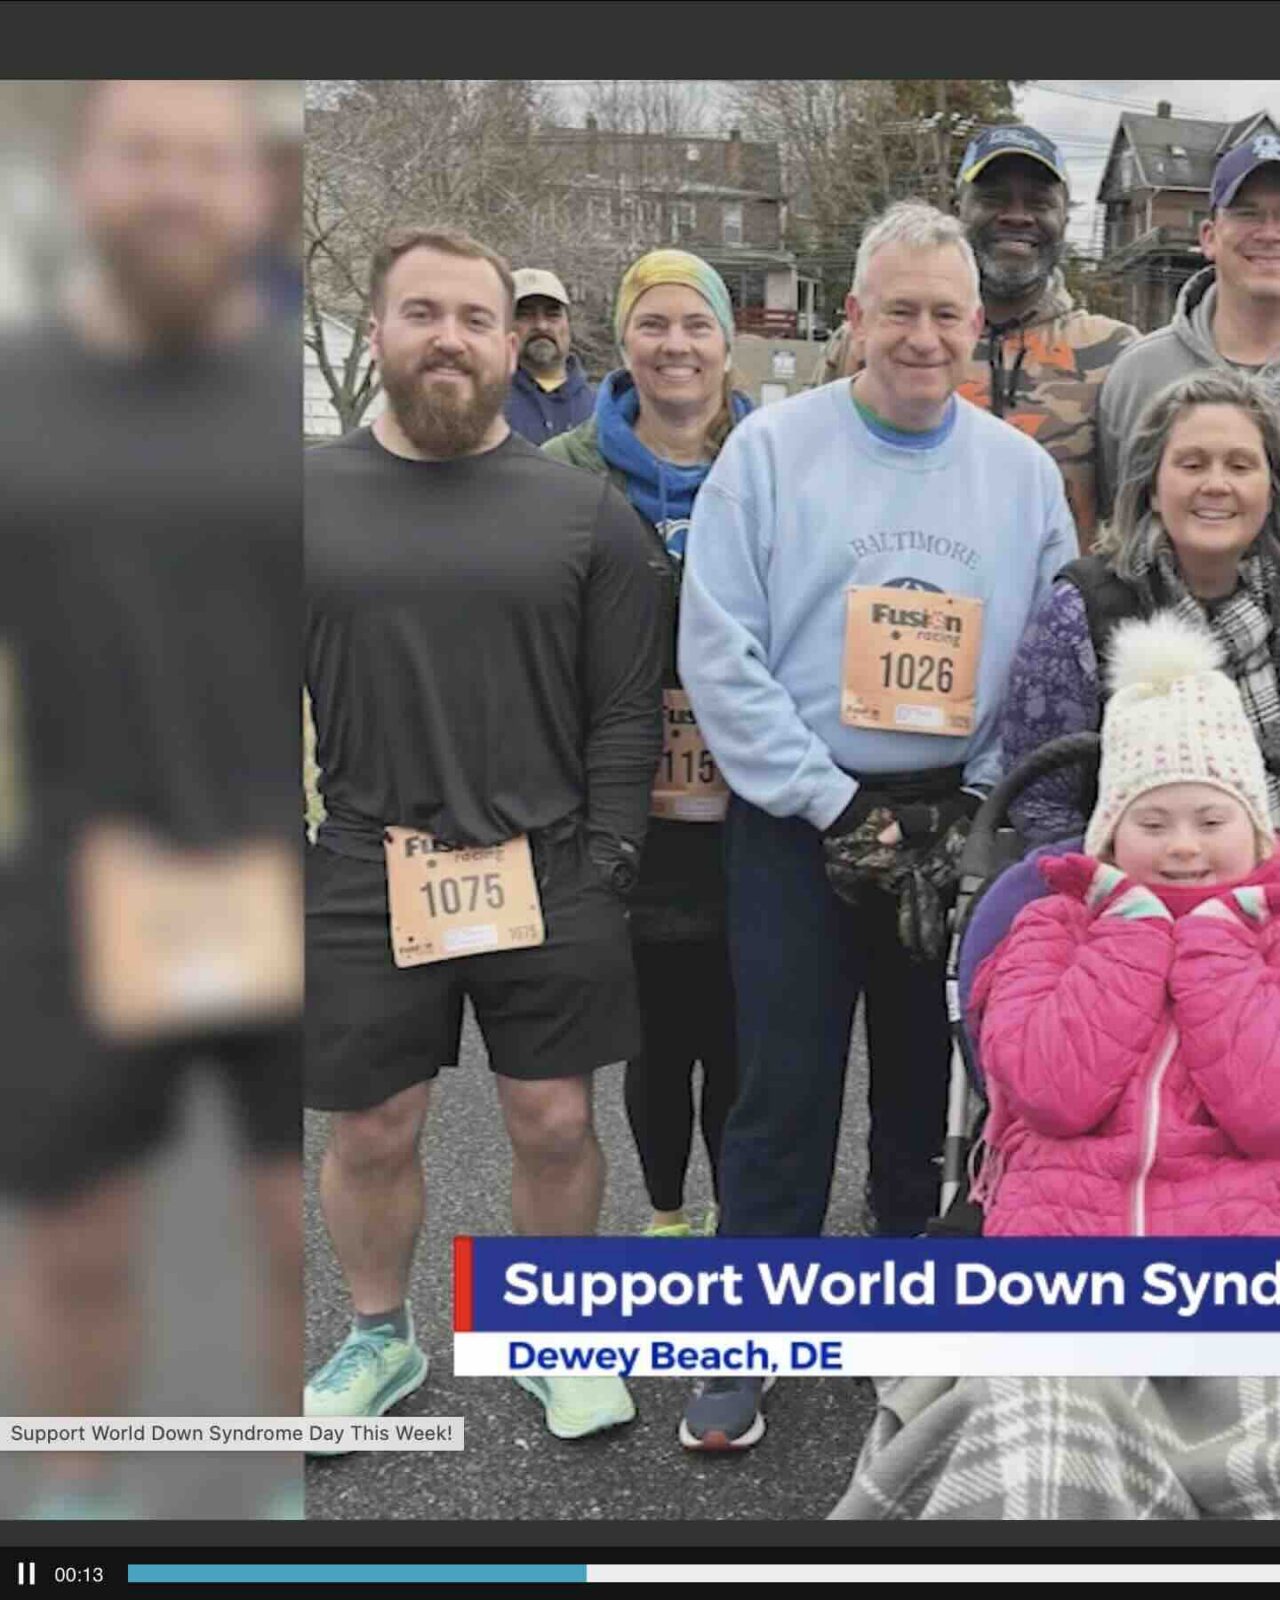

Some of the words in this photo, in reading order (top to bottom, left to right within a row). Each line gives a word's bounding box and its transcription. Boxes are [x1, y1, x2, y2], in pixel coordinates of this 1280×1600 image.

[849, 529, 982, 571] BALTIMORE
[871, 603, 963, 633] Fusion
[879, 652, 954, 693] 1026
[420, 873, 505, 918] 1075
